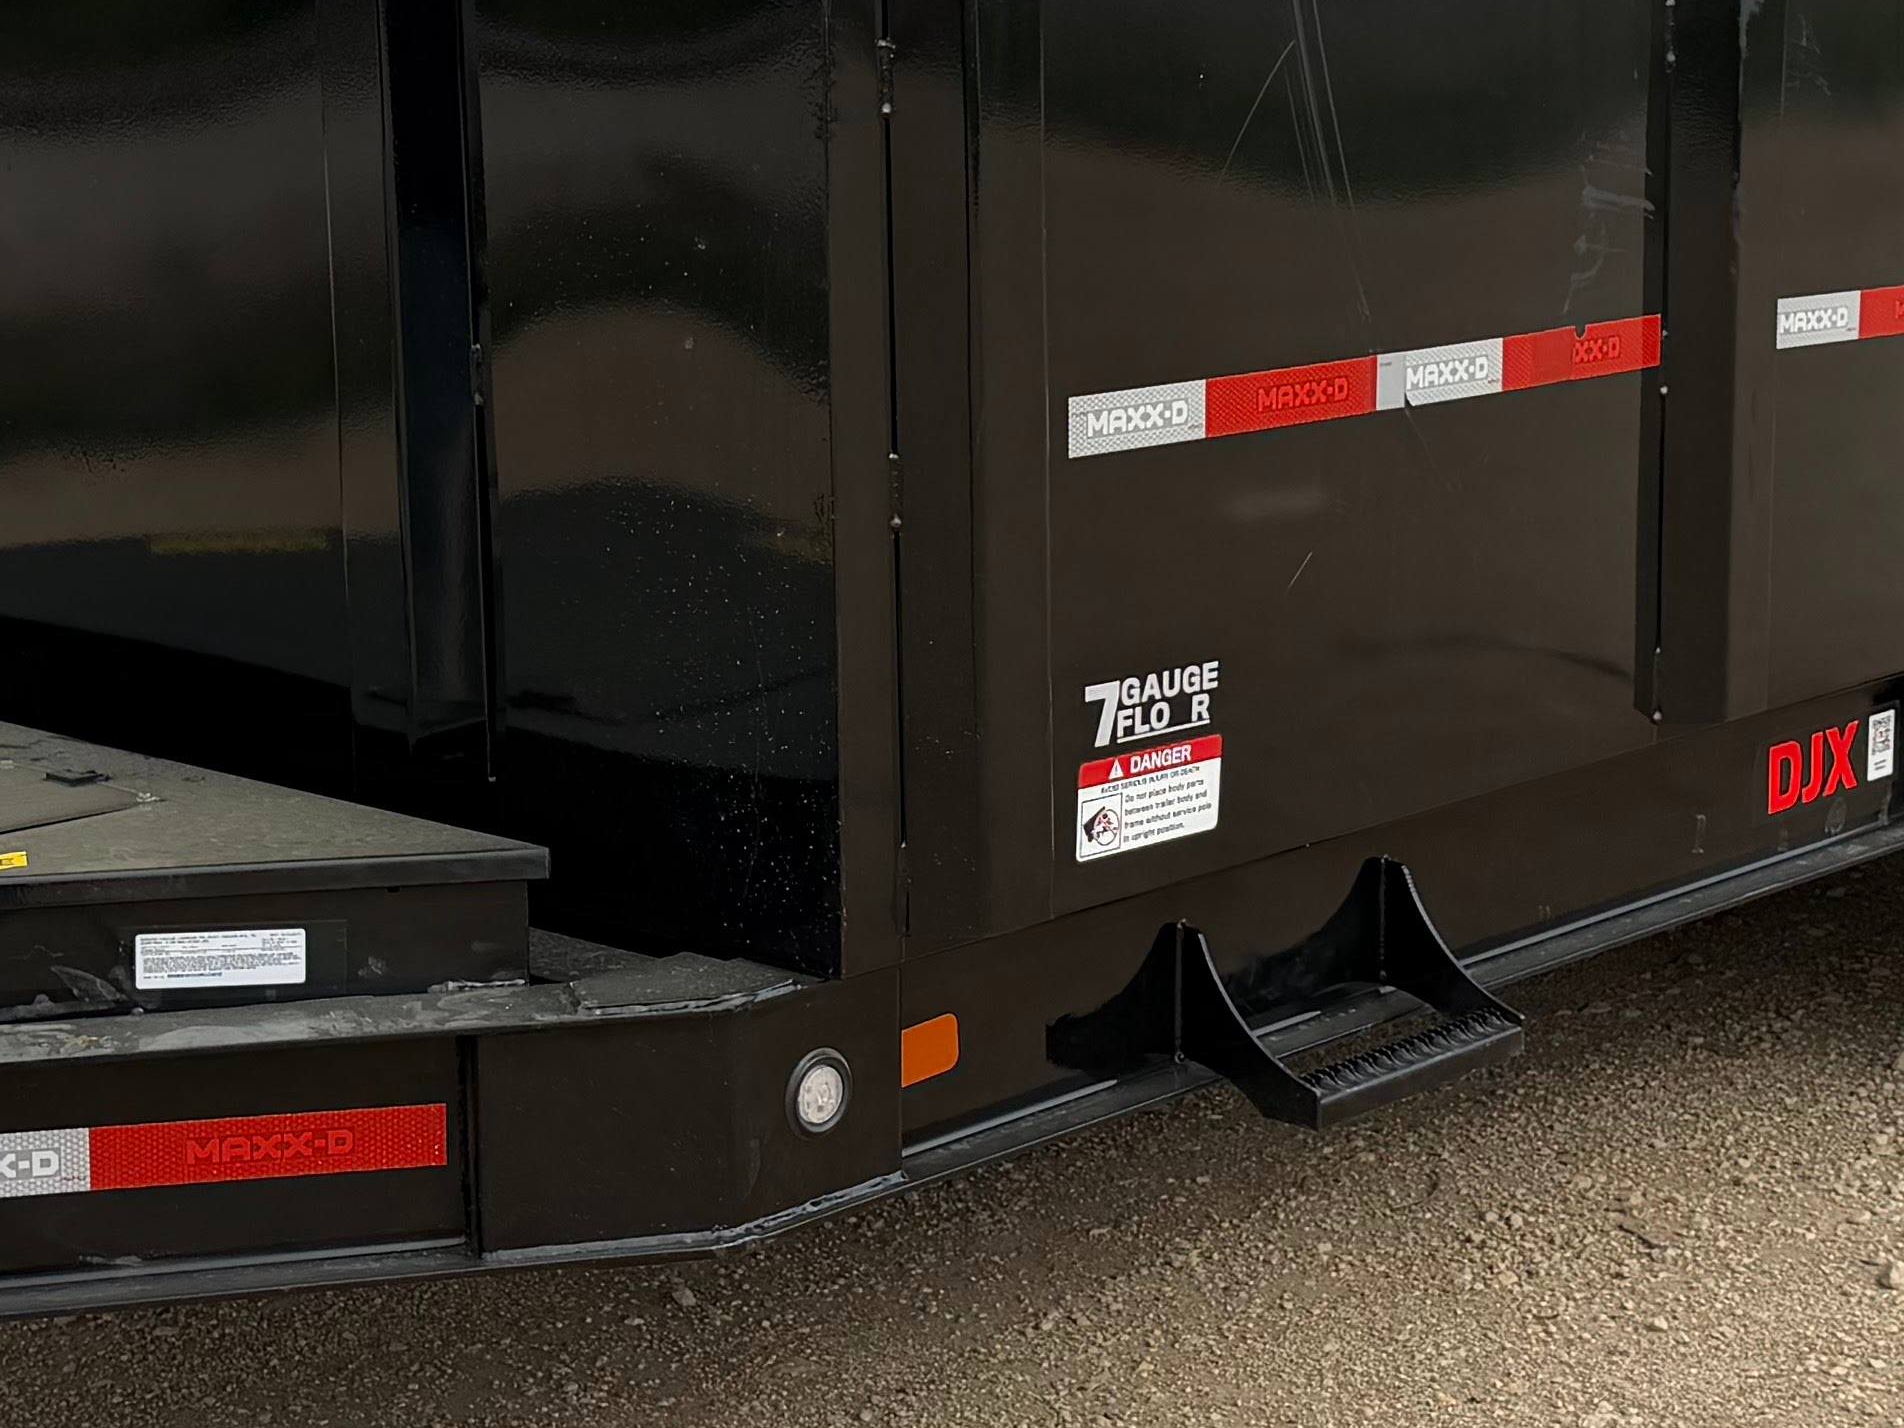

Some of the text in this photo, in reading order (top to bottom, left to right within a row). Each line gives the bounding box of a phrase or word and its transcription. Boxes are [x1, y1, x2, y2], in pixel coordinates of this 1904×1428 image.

[1779, 307, 1849, 334] MAXX-D
[1086, 399, 1188, 438] MAXX-D
[1256, 376, 1348, 412] MAXX-D
[1406, 355, 1489, 391] MAXX-D
[1085, 660, 1219, 748] 7 GAUGE
[1130, 744, 1192, 774] DANGER
[1768, 719, 1860, 815] DJX
[1149, 787, 1166, 799] place
[1168, 783, 1185, 793] body
[1177, 794, 1193, 804] body
[186, 1128, 355, 1165] MAXX-D
